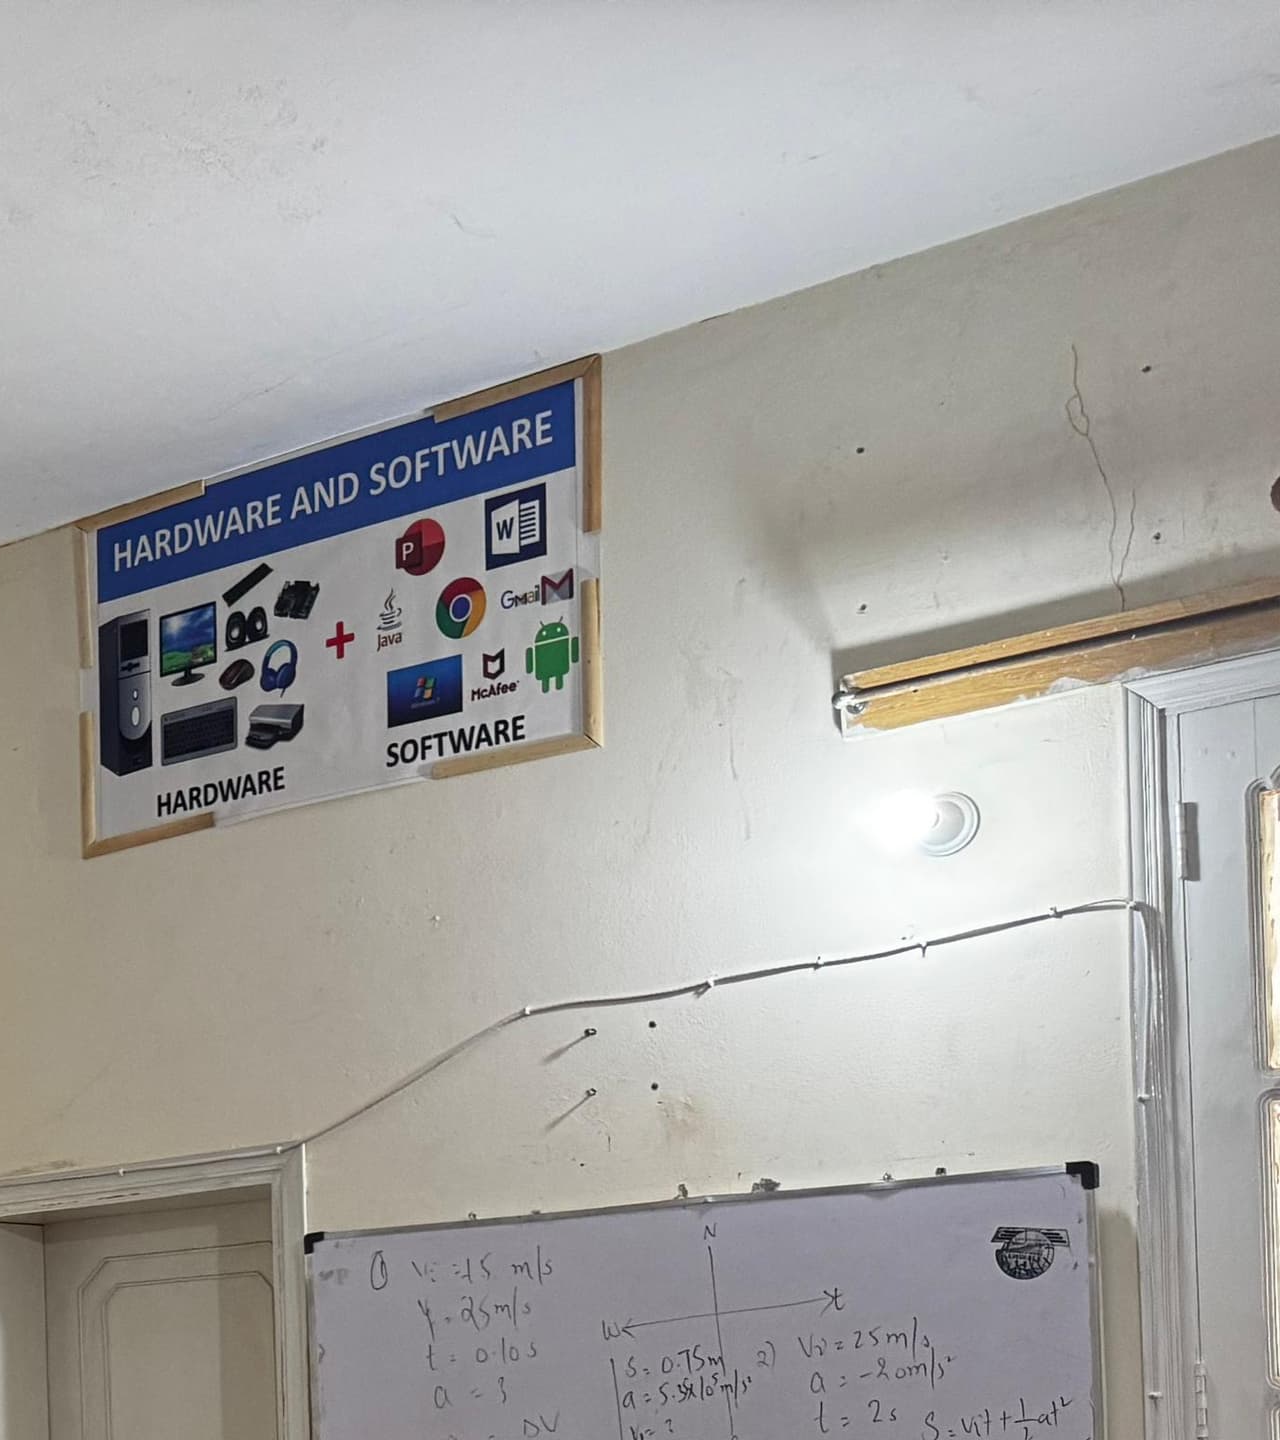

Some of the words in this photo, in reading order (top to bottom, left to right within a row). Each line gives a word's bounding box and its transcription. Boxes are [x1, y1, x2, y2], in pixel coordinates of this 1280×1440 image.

[113, 492, 283, 573] HARDWARE
[290, 471, 360, 519] AND
[368, 409, 554, 498] SOFTWARE
[376, 631, 403, 652] Java
[471, 680, 520, 702] McAfee
[385, 715, 527, 768] SOFTWARE
[156, 766, 286, 818] HARDWARE
[703, 1222, 718, 1241] N
